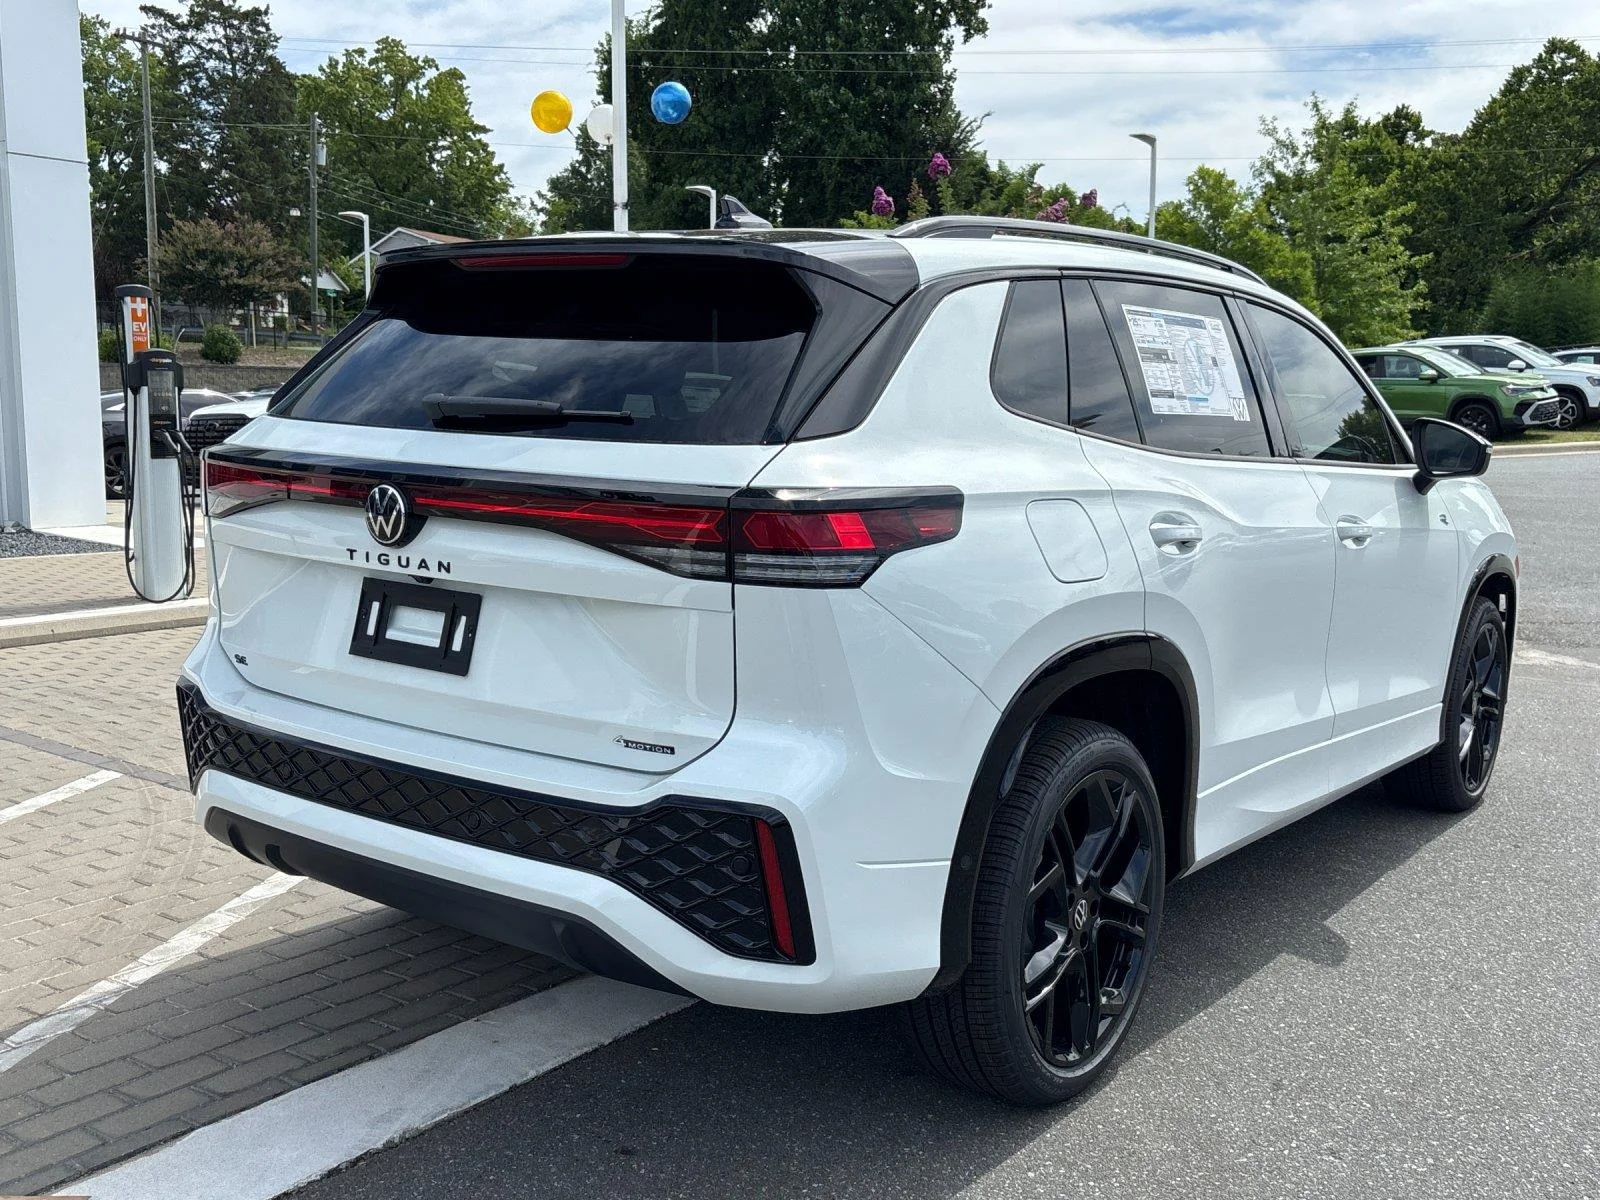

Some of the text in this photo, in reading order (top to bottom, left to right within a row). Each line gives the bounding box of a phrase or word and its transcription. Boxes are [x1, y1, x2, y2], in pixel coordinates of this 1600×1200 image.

[133, 321, 147, 332] EV
[367, 485, 404, 543] VW
[345, 547, 452, 575] TIGUAN
[233, 653, 249, 667] SE
[612, 734, 674, 755] 4MOTION
